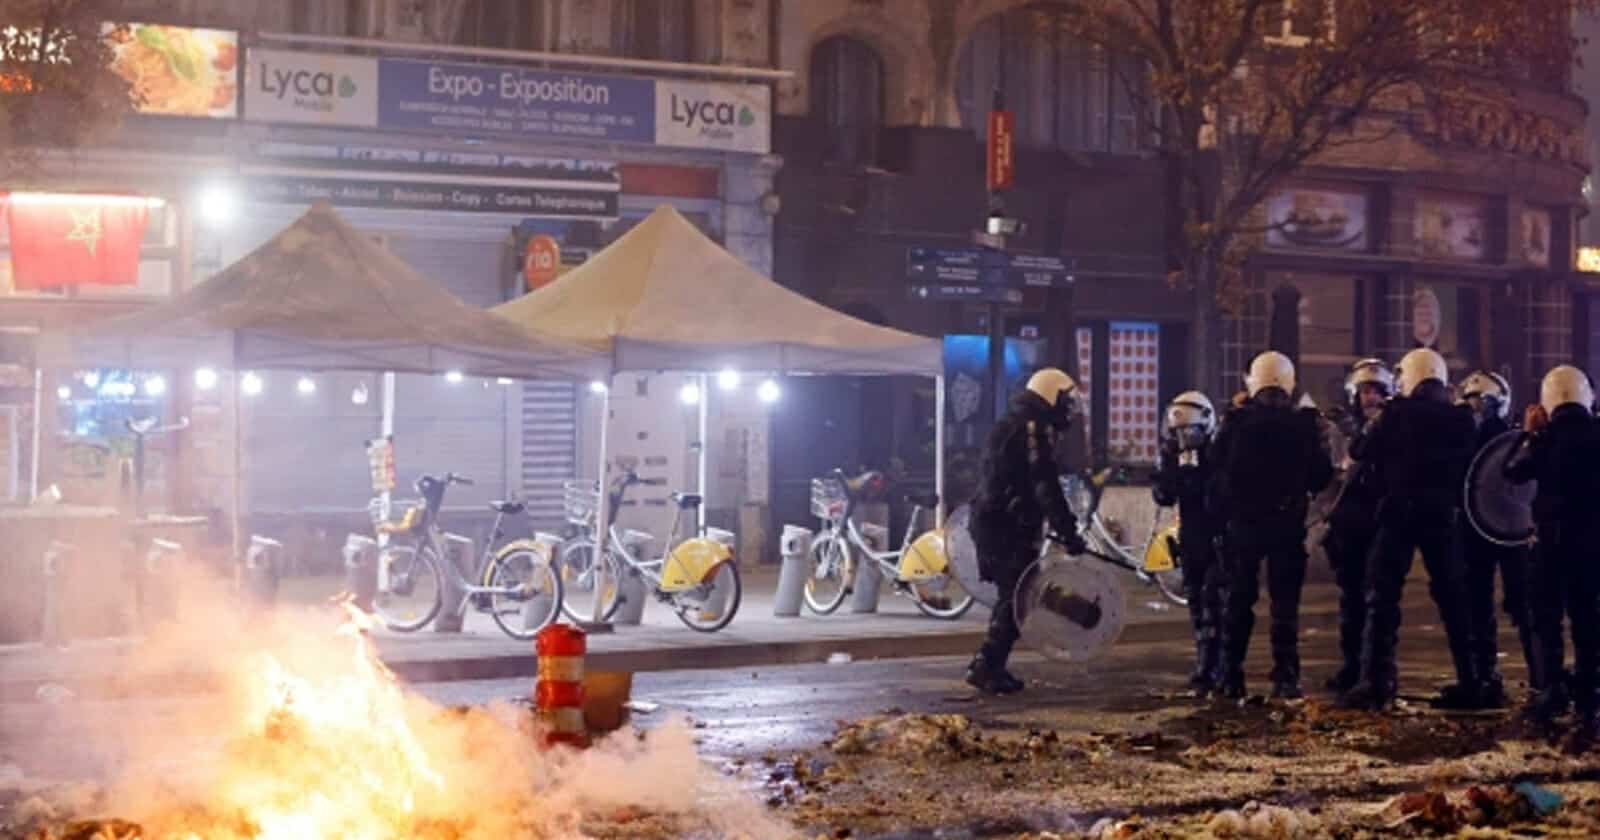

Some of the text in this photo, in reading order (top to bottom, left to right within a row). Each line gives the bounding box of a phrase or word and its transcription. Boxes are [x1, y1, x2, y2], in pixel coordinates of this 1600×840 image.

[260, 63, 334, 99] Lyca
[428, 66, 483, 99] Expo
[500, 72, 609, 104] Exposition
[671, 94, 734, 128] Lyca
[452, 190, 481, 206] Copy
